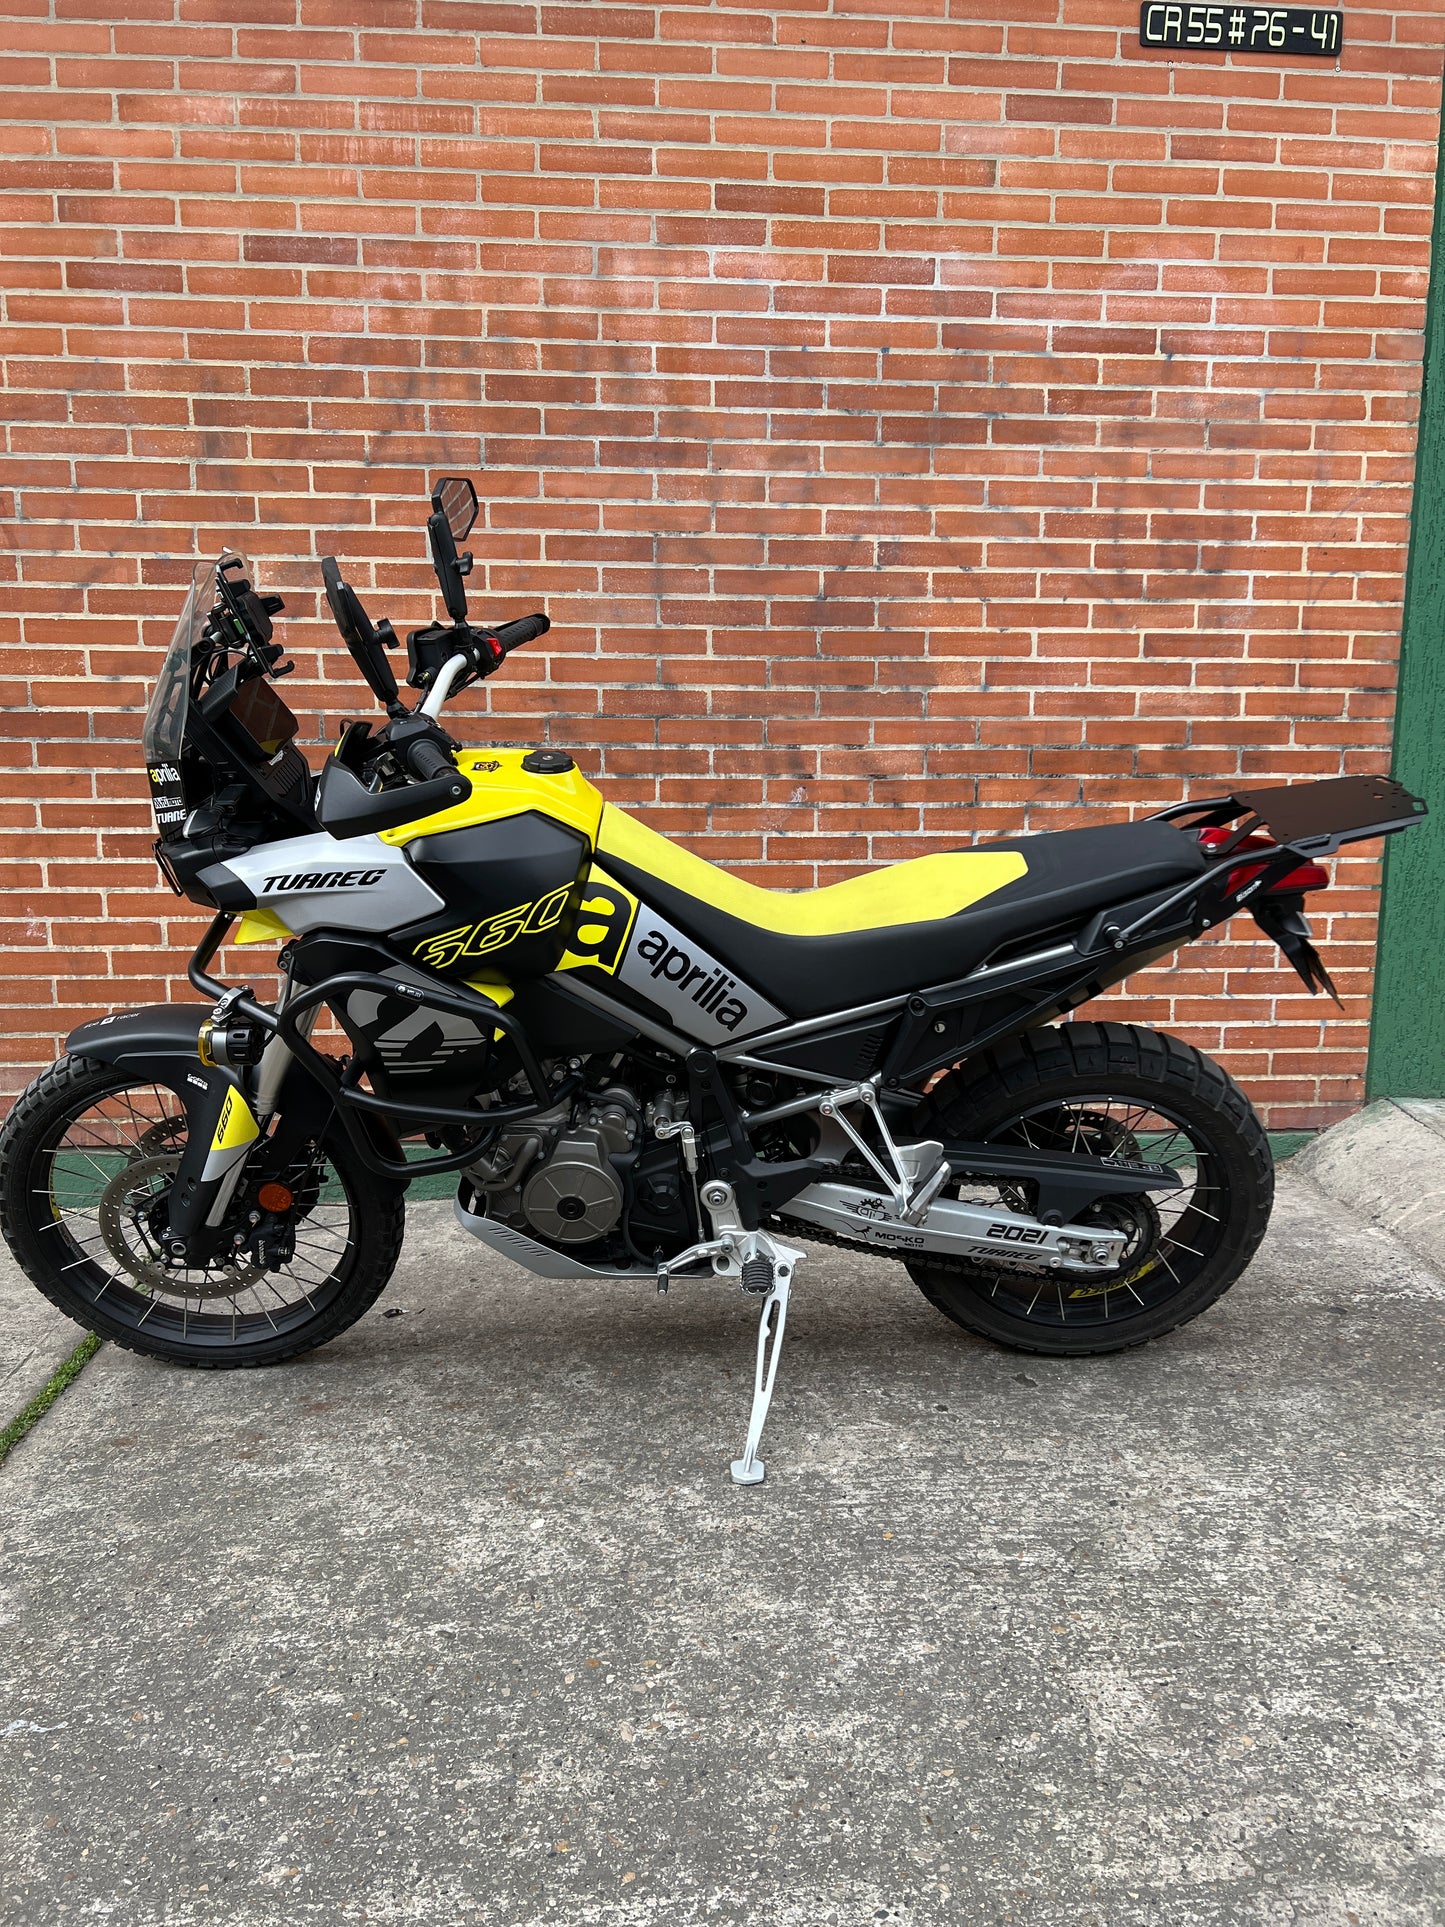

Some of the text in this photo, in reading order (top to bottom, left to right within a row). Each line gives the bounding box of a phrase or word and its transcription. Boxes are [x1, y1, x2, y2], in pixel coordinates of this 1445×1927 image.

[149, 763, 181, 786] aprilia
[262, 869, 388, 893] TUAREG
[636, 929, 749, 1033] aprilia
[216, 1094, 233, 1145] 660
[874, 1231, 925, 1244] MOSKO
[985, 1223, 1050, 1245] 2021
[967, 1245, 1043, 1261] TUAREG
